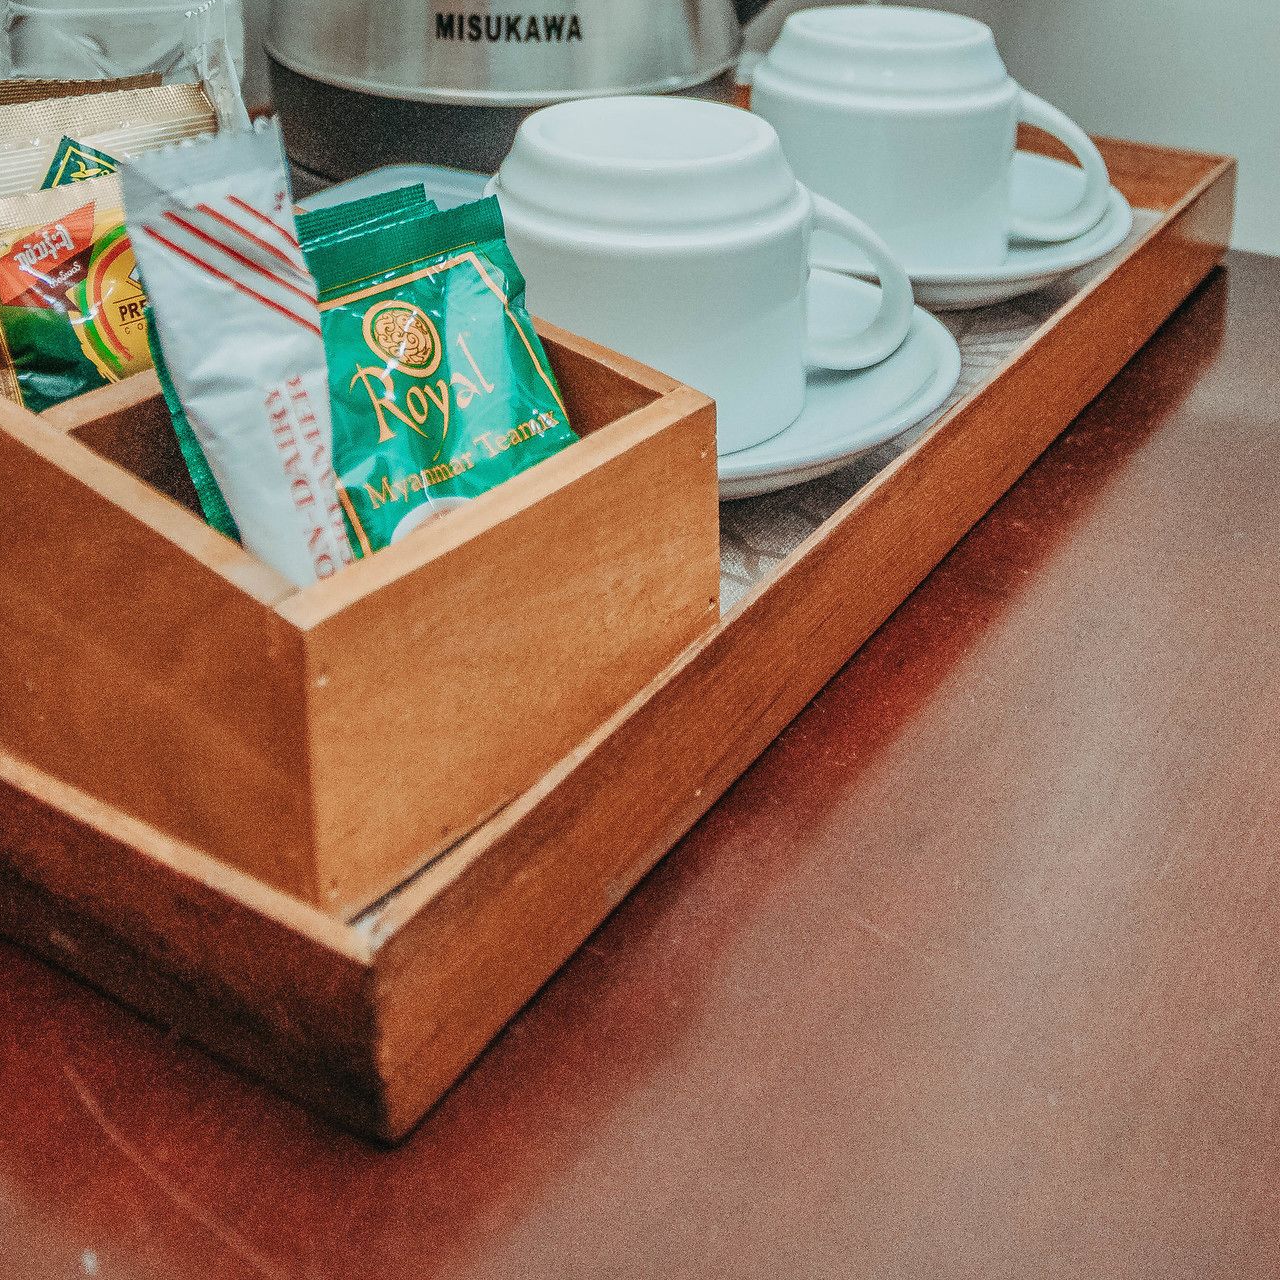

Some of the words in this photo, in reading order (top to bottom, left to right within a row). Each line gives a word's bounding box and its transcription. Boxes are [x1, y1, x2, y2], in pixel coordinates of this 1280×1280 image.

[435, 13, 583, 42] MISUKAWA
[349, 332, 495, 461] Royal
[363, 450, 473, 510] Myanmar
